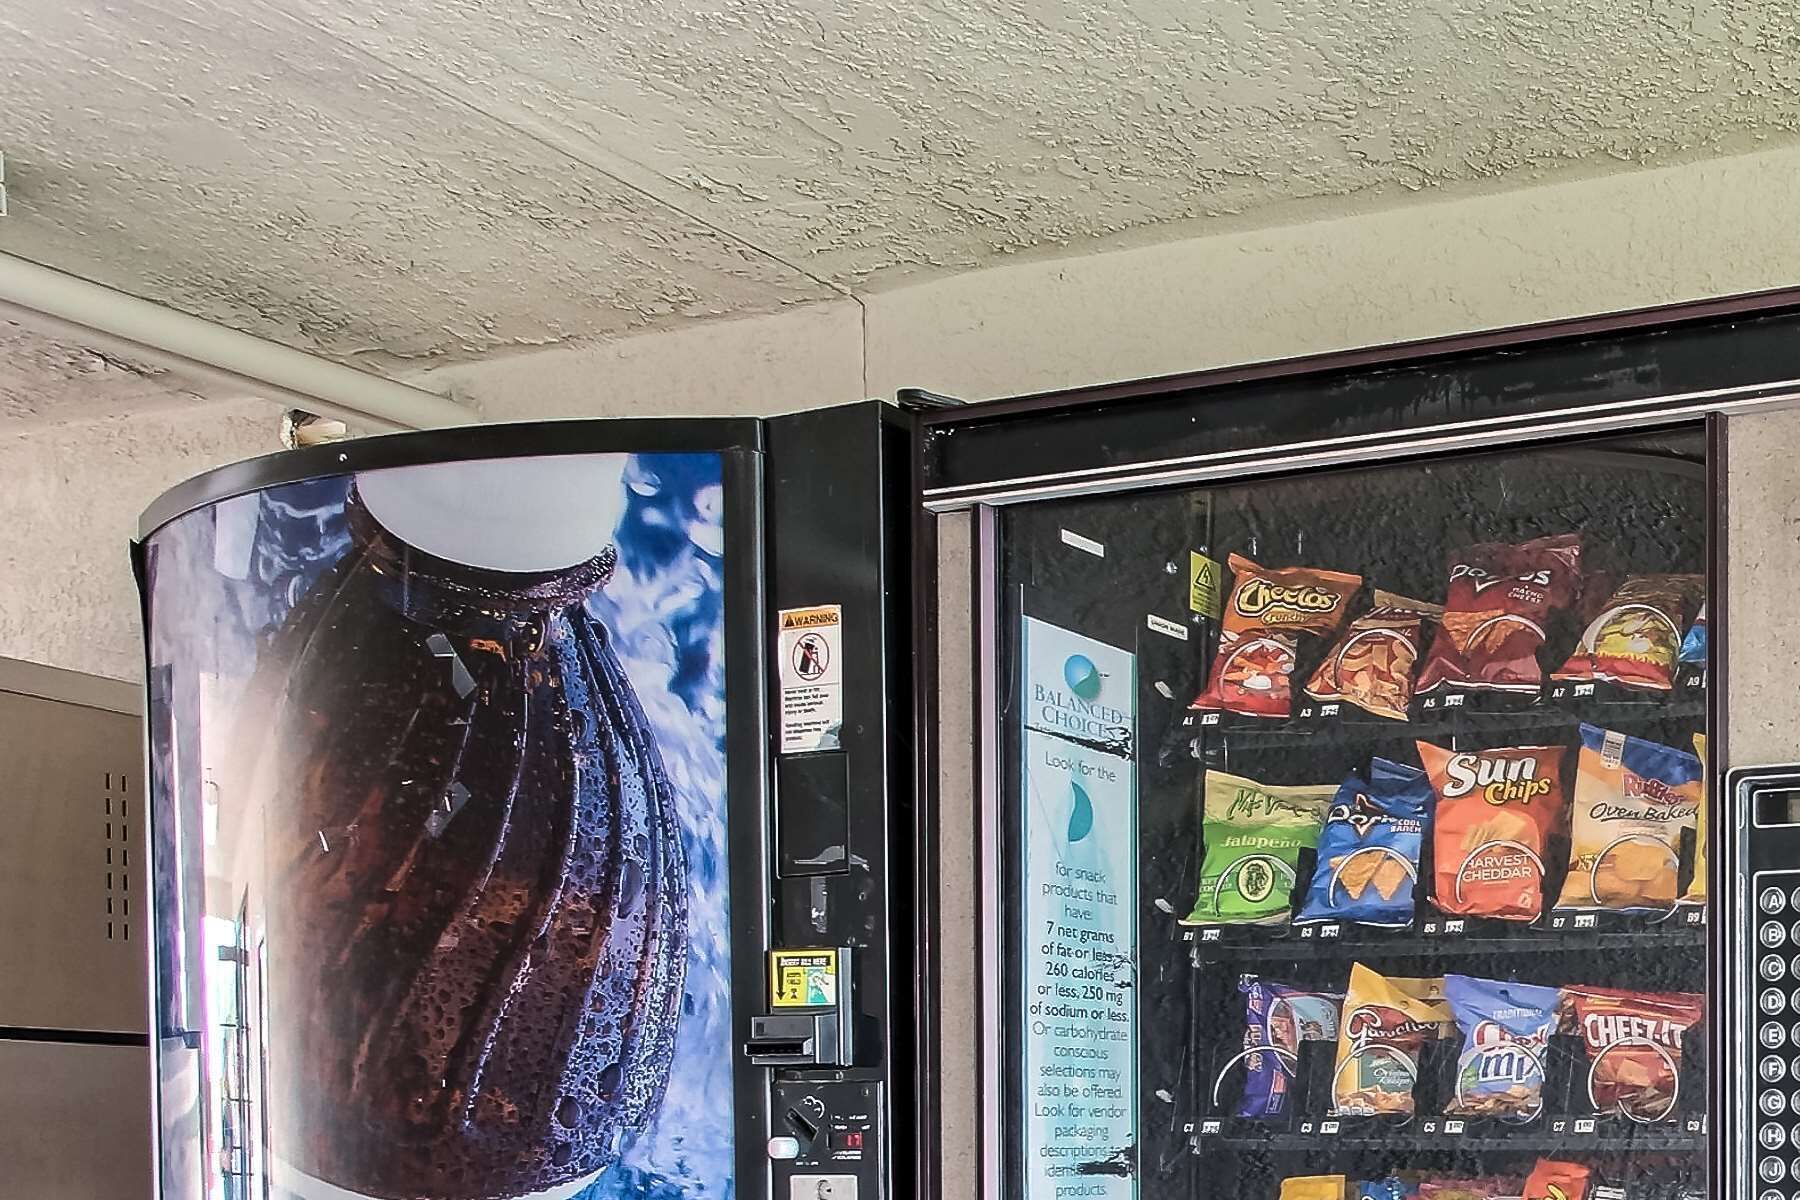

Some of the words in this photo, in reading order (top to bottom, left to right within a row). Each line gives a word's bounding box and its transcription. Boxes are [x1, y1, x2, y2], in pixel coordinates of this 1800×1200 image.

[1237, 577, 1342, 612] Cheetos
[794, 611, 839, 626] WARNING
[1552, 687, 1565, 698] A7
[1034, 684, 1123, 725] BALANCED
[1183, 716, 1194, 726] A1
[1045, 750, 1074, 771] Look
[1078, 760, 1096, 776] for
[1098, 765, 1117, 782] the
[1442, 752, 1538, 799] Sun
[1484, 775, 1552, 806] Chips
[1589, 801, 1642, 822] Oven
[1643, 804, 1699, 821] Baked
[1390, 825, 1422, 834] RANCH
[1398, 818, 1422, 828] COOL
[1466, 853, 1532, 868] HARVEST
[1055, 861, 1073, 878] for
[1075, 866, 1106, 884] snack
[1461, 866, 1532, 882] CHEDDAR
[1042, 882, 1093, 903] products
[1096, 888, 1118, 906] that
[1768, 895, 1780, 909] A
[1553, 918, 1565, 928] B7
[1046, 920, 1055, 935] 7
[1057, 926, 1079, 939] net
[1080, 929, 1115, 944] grams
[1302, 928, 1312, 938] B3
[1768, 929, 1780, 942] B
[1041, 942, 1055, 956] of
[1056, 943, 1073, 957] fat
[1075, 948, 1089, 960] or
[1045, 961, 1068, 977] 260
[1071, 966, 1115, 983] calories
[1768, 962, 1781, 976] C
[1037, 984, 1051, 996] or
[1082, 986, 1104, 1001] 250
[1105, 991, 1123, 1006] mg
[1029, 1001, 1043, 1015] of
[1045, 1004, 1088, 1019] sodium
[1091, 1008, 1105, 1020] or
[1768, 996, 1780, 1010] D
[1493, 1007, 1543, 1021] TRADITIONAL
[1032, 1020, 1051, 1036] Or
[1054, 1023, 1128, 1043] carbohydrate
[1583, 1012, 1688, 1049] CHEEZ-IT
[1768, 1029, 1780, 1043] E
[1053, 1045, 1109, 1060] conscious
[1040, 1064, 1096, 1080] selections
[1098, 1068, 1120, 1084] may
[1768, 1062, 1780, 1077] F
[1037, 1082, 1060, 1098] also
[1063, 1084, 1079, 1098] be
[1034, 1102, 1065, 1118] Look
[1068, 1103, 1086, 1118] for
[1088, 1104, 1128, 1119] vendor
[1768, 1096, 1780, 1110] G
[1054, 1123, 1110, 1142] packaging
[1554, 1122, 1565, 1132] C7
[1768, 1130, 1780, 1144] H
[1039, 1144, 1107, 1159] descriptions
[1768, 1163, 1779, 1177] J
